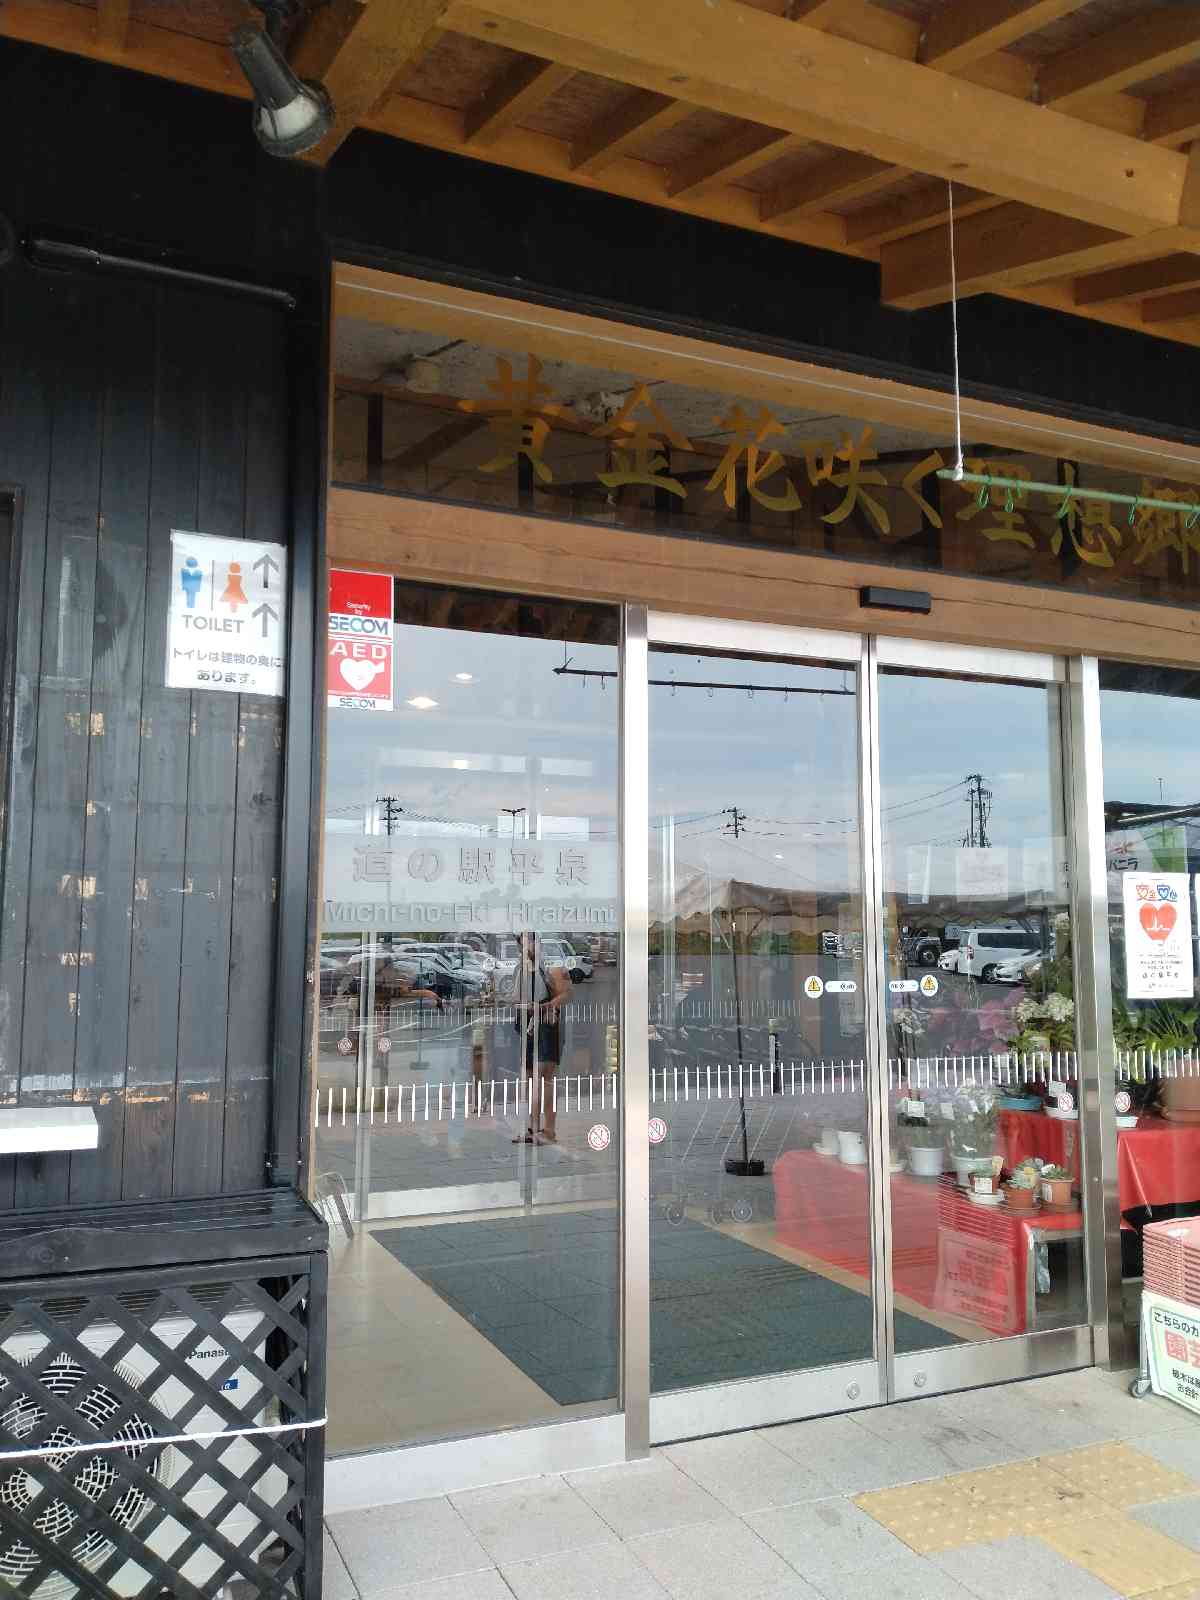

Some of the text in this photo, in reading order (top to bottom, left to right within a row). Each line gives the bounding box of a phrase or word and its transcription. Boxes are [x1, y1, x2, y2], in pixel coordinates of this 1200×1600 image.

[181, 614, 245, 633] TOILET
[328, 615, 389, 635] SECOM
[173, 647, 284, 669] トイレは建物の奥に
[329, 641, 387, 660] AED
[197, 669, 257, 686] あります。
[339, 697, 377, 709] SECOM
[352, 847, 592, 886] 道の駅平泉
